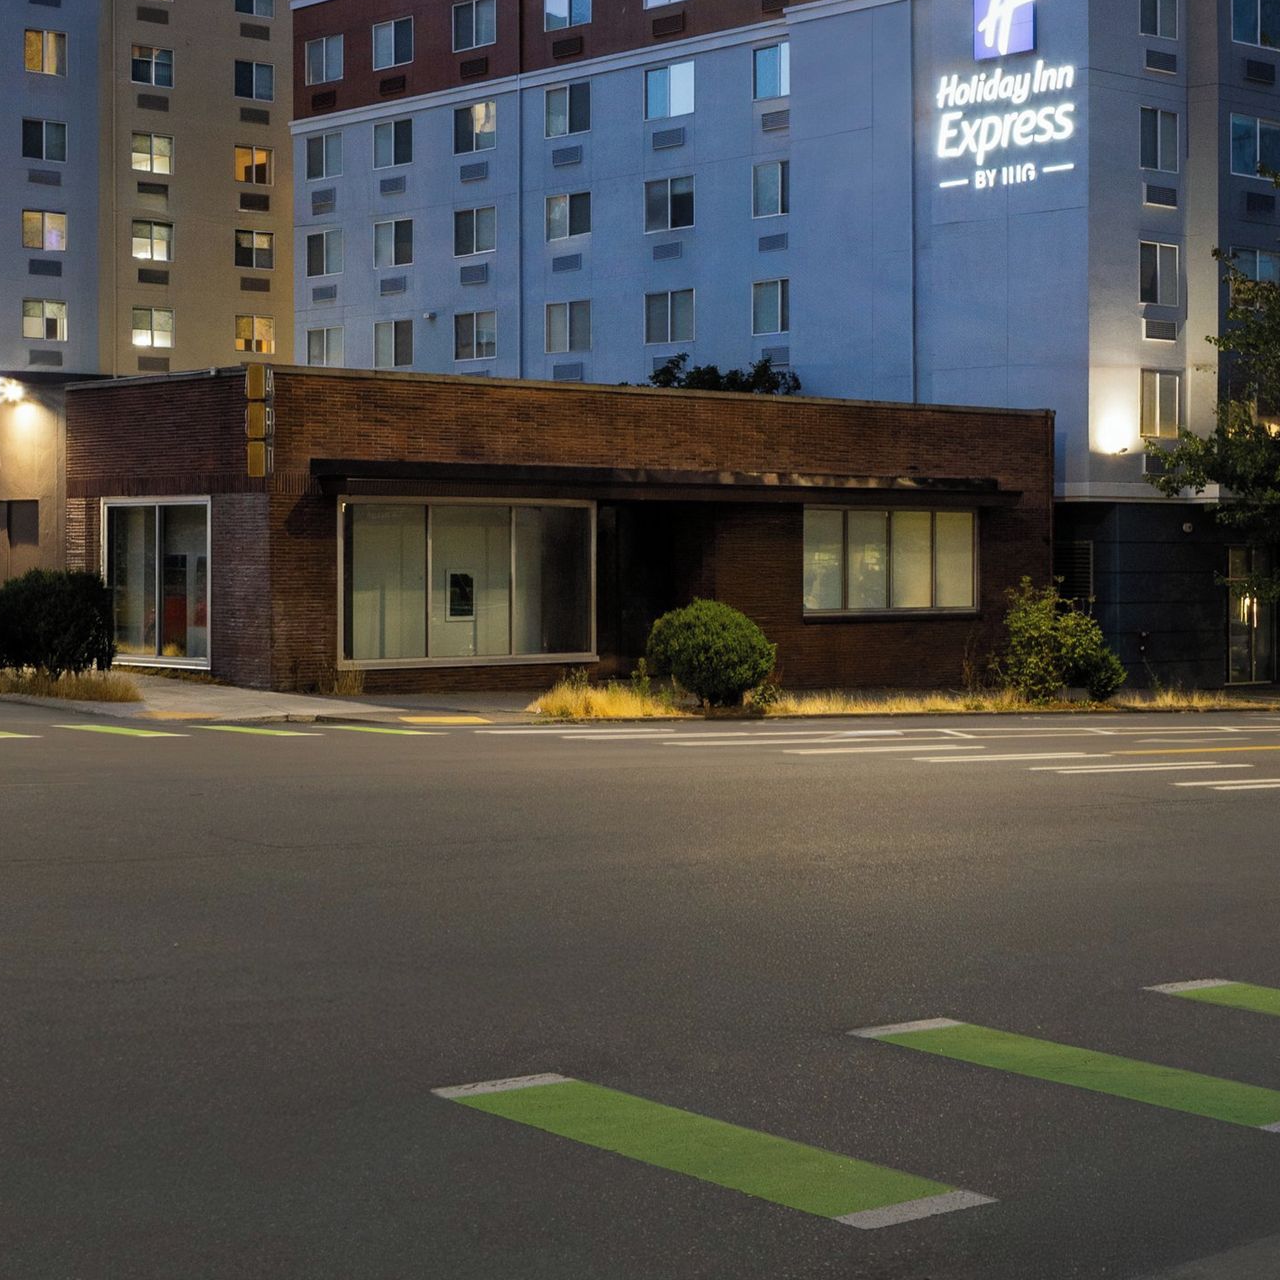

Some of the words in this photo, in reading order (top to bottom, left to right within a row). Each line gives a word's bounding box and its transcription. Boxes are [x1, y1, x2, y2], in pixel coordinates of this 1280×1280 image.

[936, 68, 1031, 109] Holiday
[1032, 60, 1075, 94] Inn
[936, 102, 1076, 166] Express
[975, 168, 997, 189] BY
